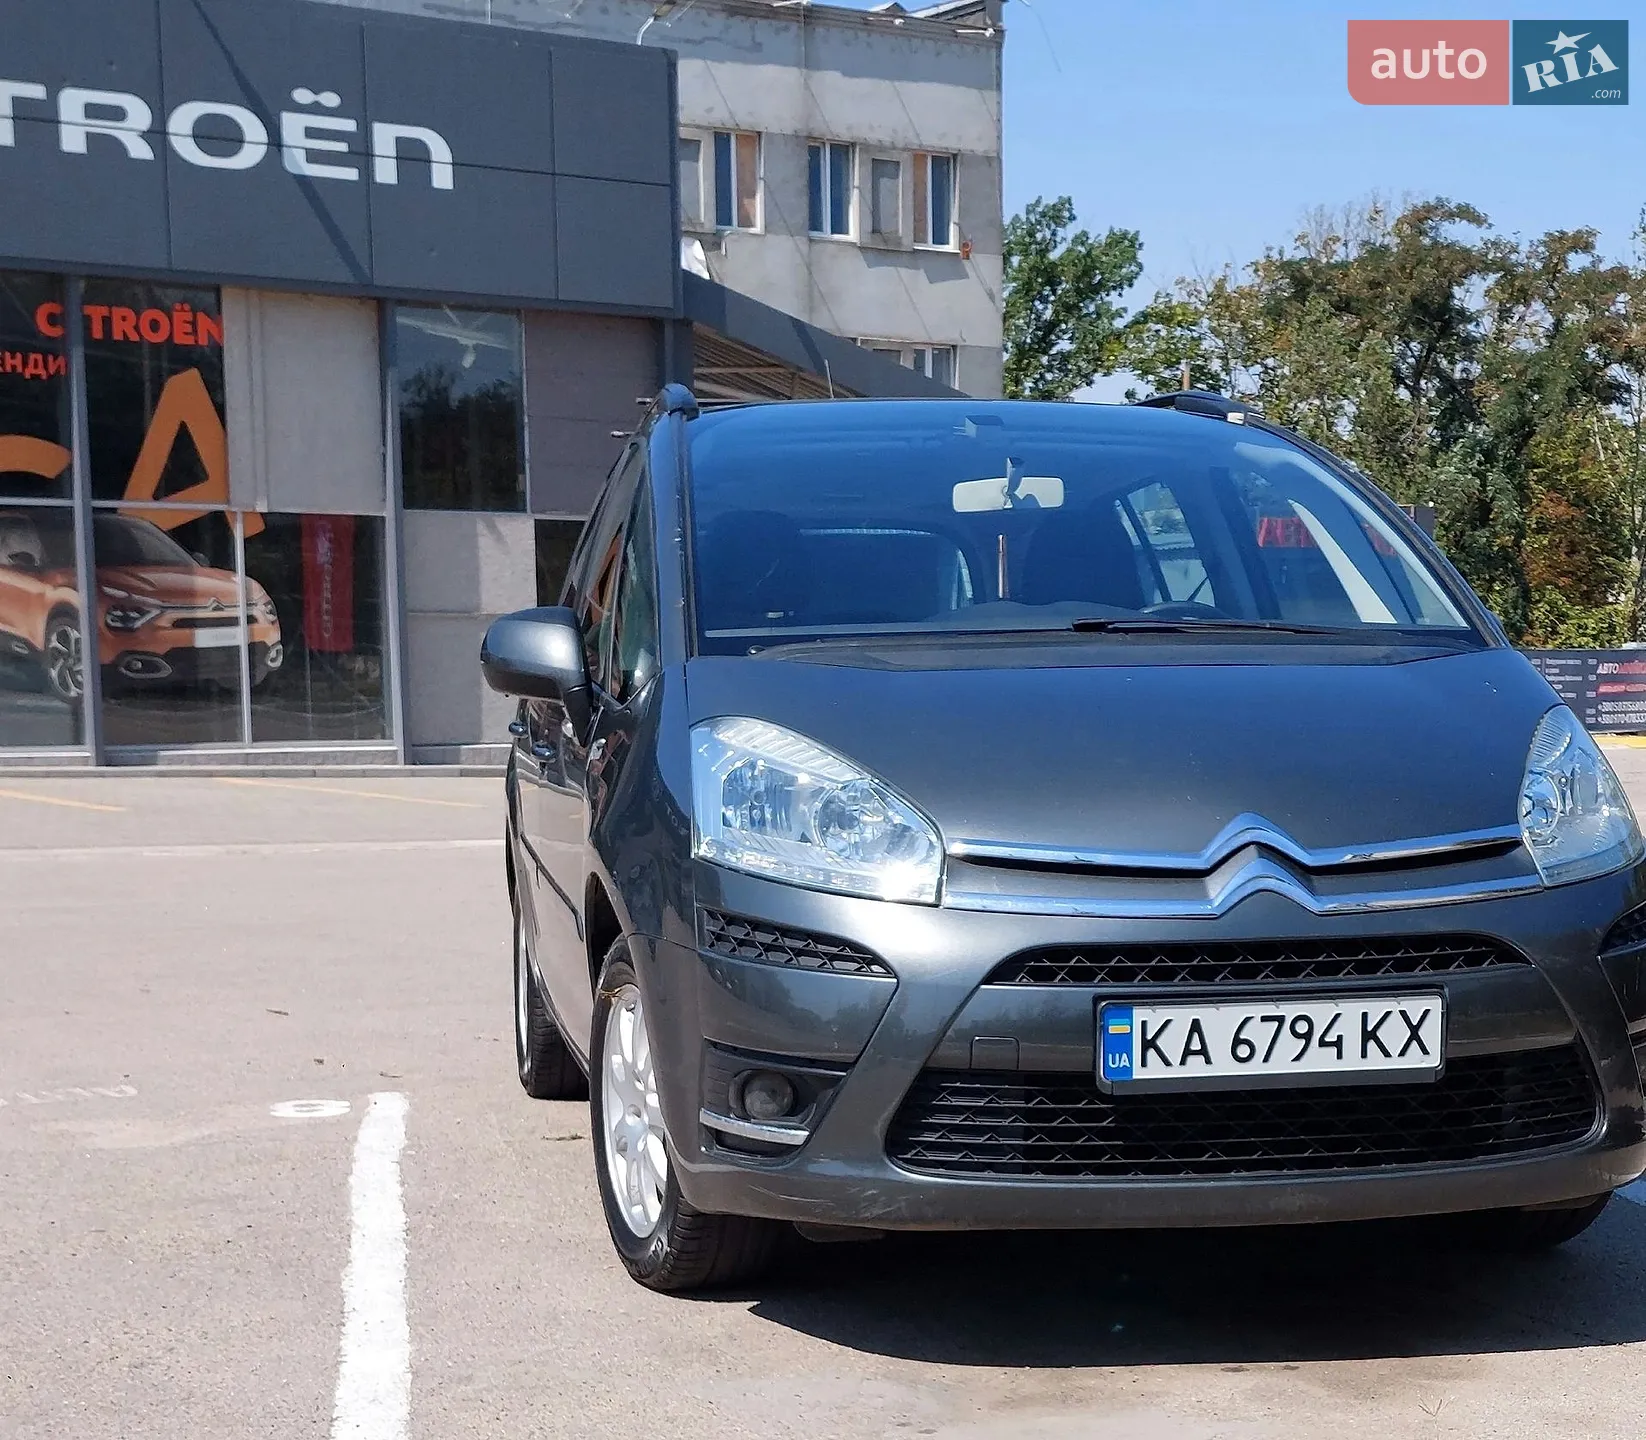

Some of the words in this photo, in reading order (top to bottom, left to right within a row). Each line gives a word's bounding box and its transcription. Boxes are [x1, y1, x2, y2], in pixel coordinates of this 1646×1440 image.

[35, 302, 224, 347] CTROËN
[1140, 1017, 1213, 1068] KA
[1230, 1012, 1344, 1064] 6794
[1360, 1008, 1432, 1060] KX
[1108, 1054, 1131, 1068] UA
